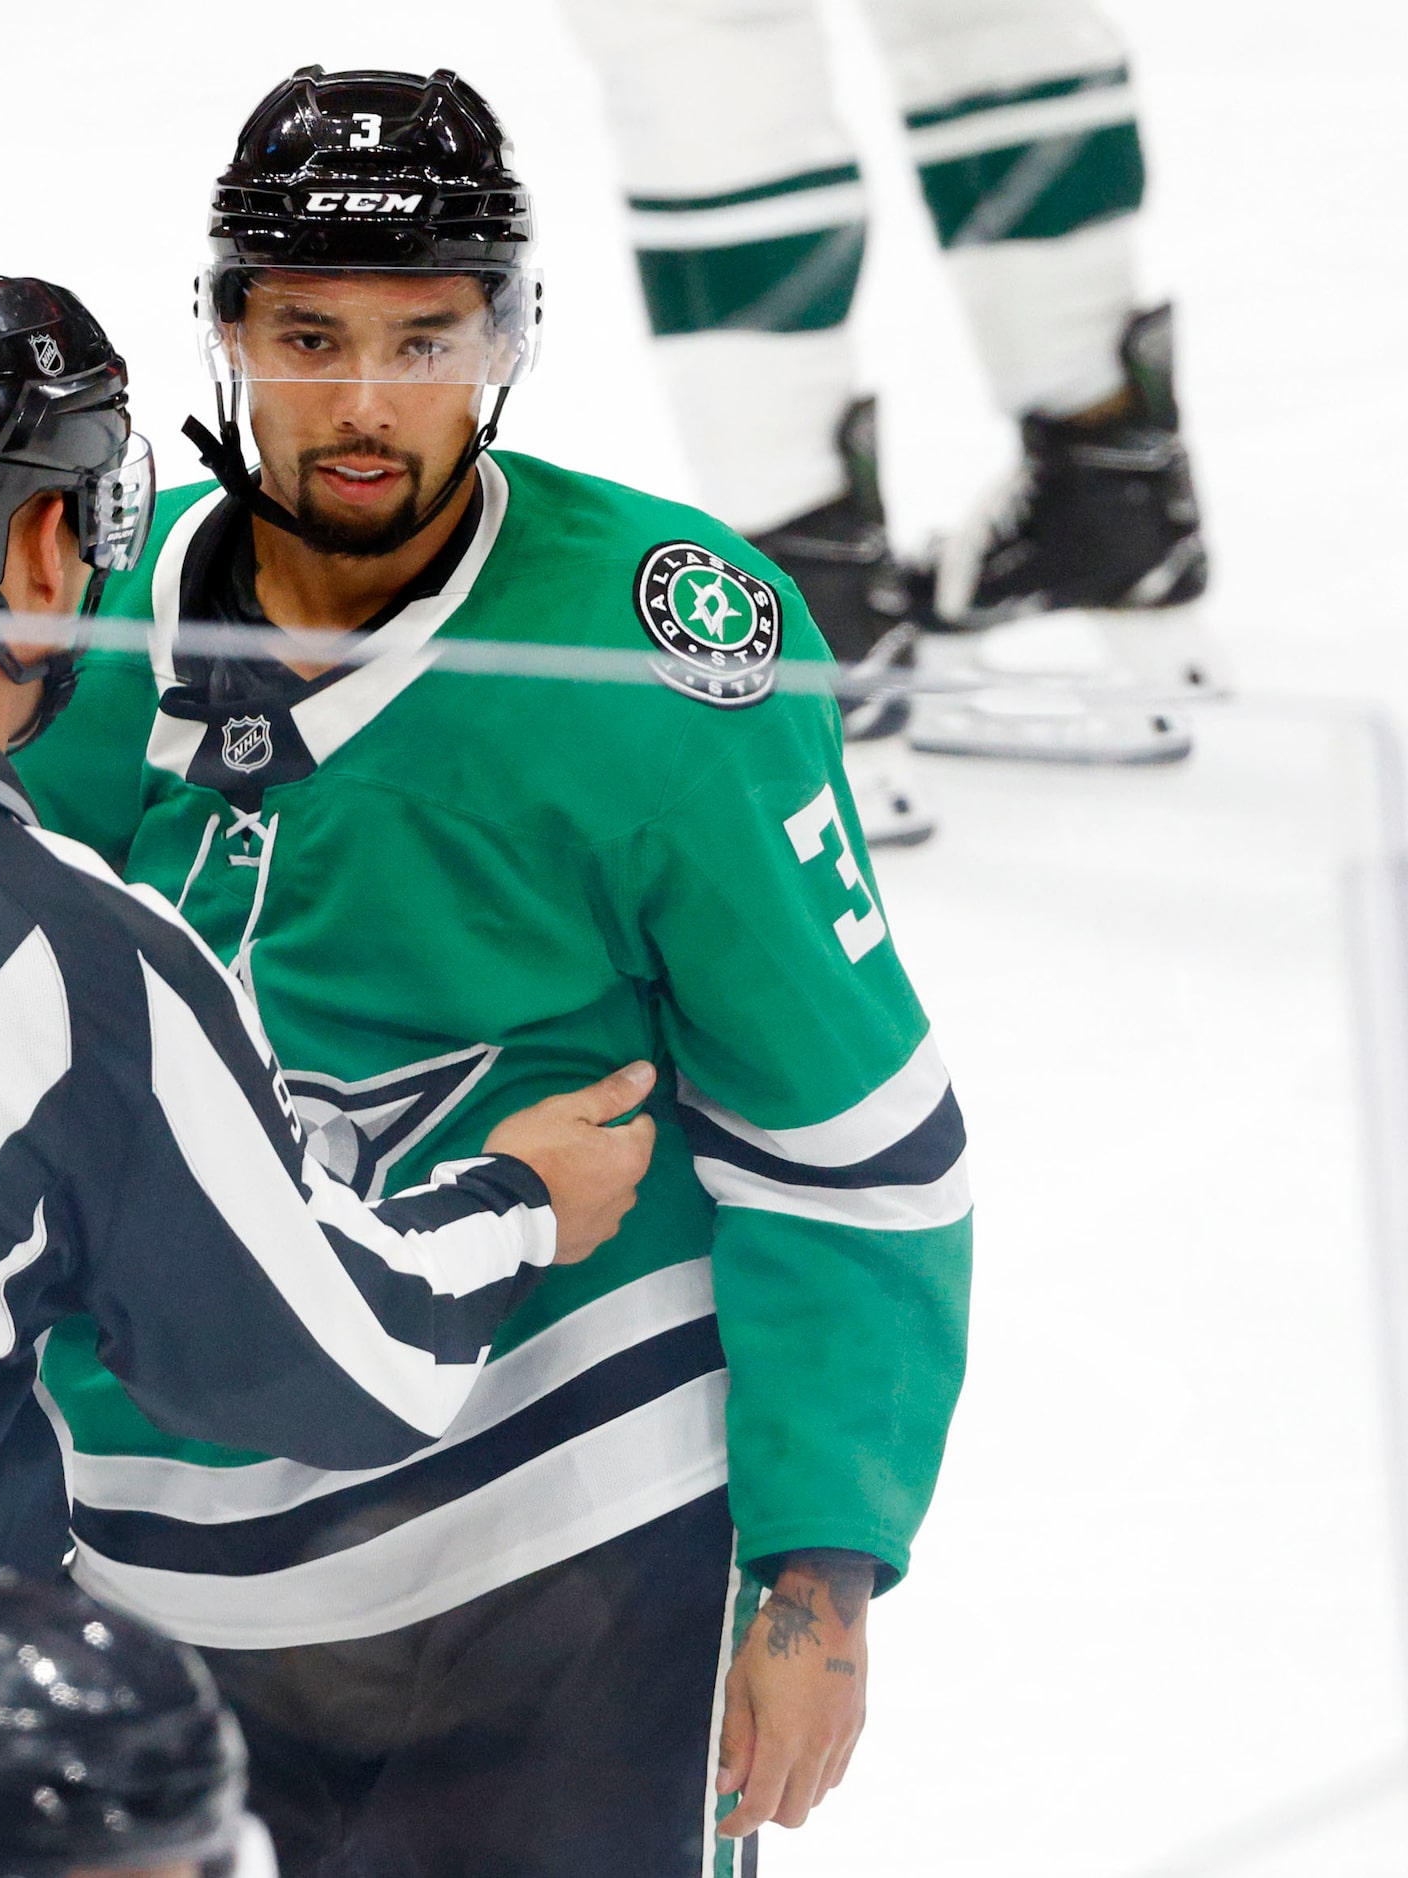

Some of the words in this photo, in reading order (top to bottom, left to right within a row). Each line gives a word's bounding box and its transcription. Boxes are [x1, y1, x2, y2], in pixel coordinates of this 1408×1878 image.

[349, 112, 382, 147] 3
[306, 192, 423, 213] CCM
[41, 344, 55, 368] NHL
[650, 551, 725, 660] DALLAS
[711, 590, 772, 667] STARS
[233, 730, 261, 760] NHL
[782, 782, 886, 965] 3
